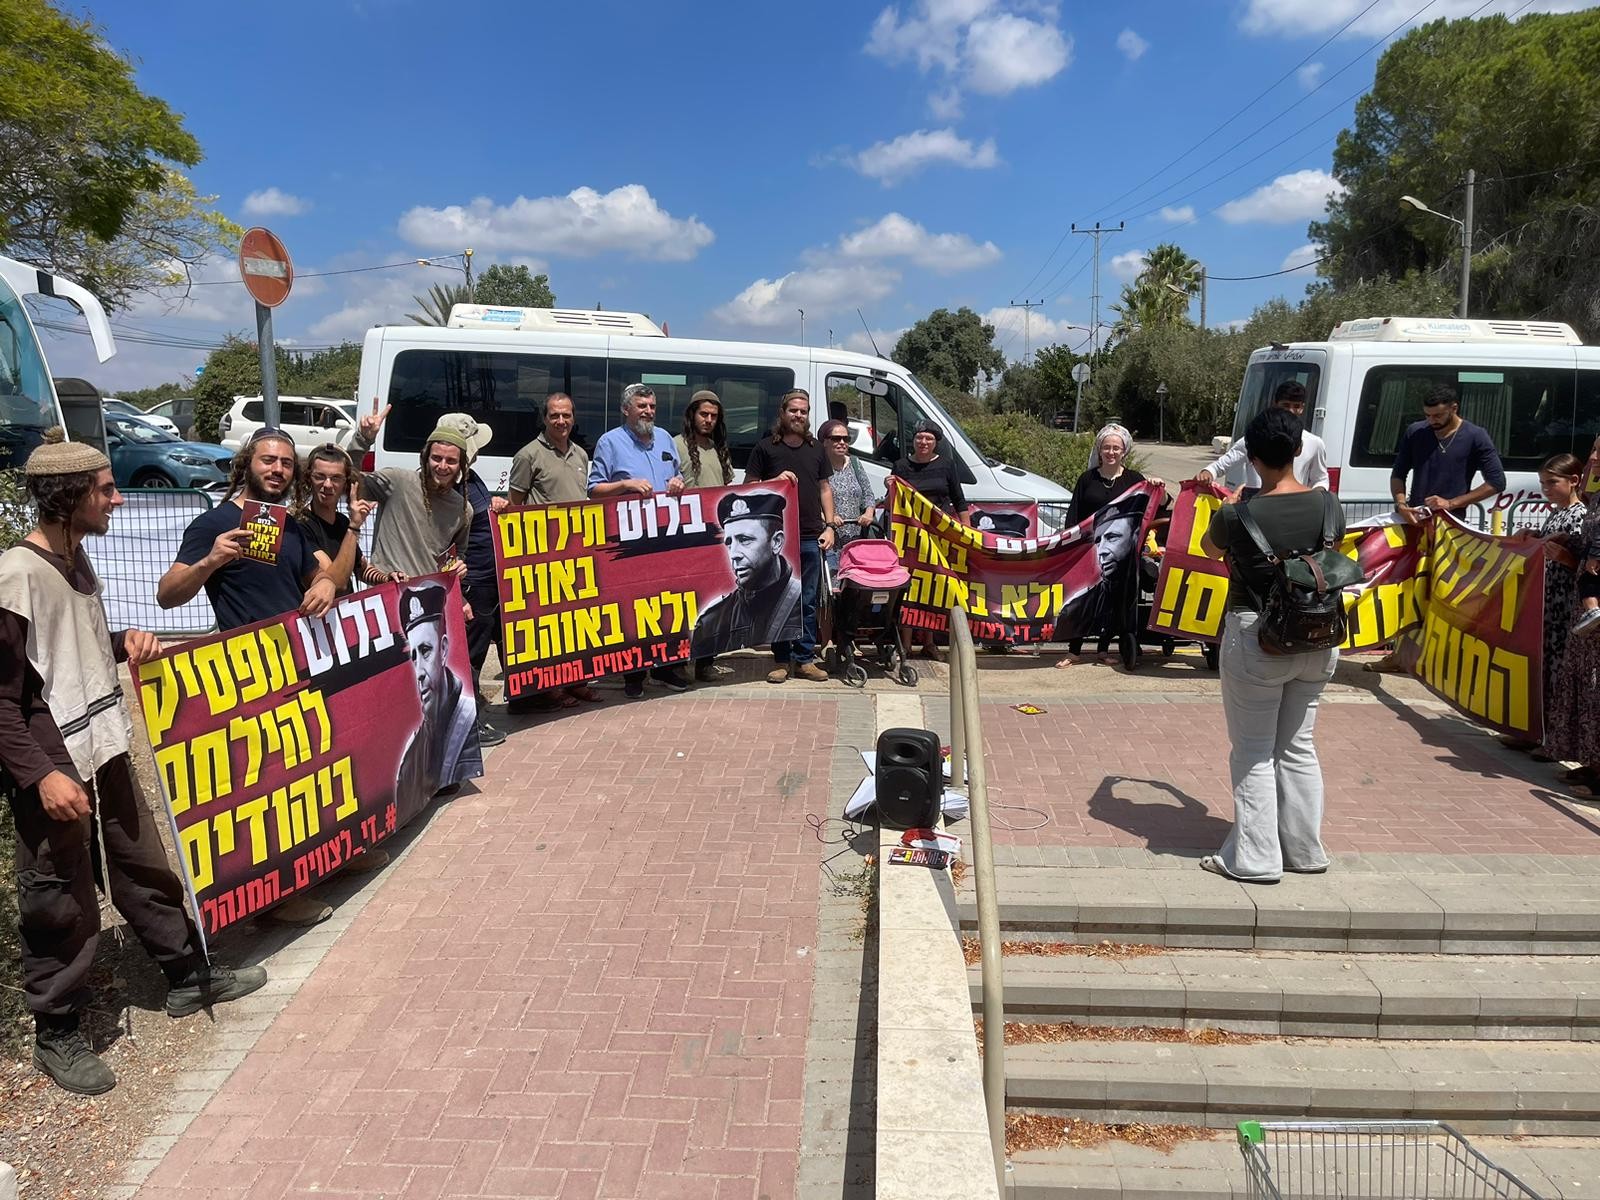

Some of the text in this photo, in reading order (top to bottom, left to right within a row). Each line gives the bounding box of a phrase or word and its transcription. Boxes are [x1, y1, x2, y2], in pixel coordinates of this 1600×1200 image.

[250, 540, 270, 552] ולא
[498, 494, 706, 559] בלוט תילחם
[891, 522, 968, 574] באויב
[503, 556, 599, 613] באויב
[1001, 582, 1064, 618] ולא
[505, 591, 699, 667] ולא באוהב!
[139, 594, 395, 746] בלוט תפסיק
[154, 687, 332, 818] להילחם
[178, 756, 359, 894] ביהודים
